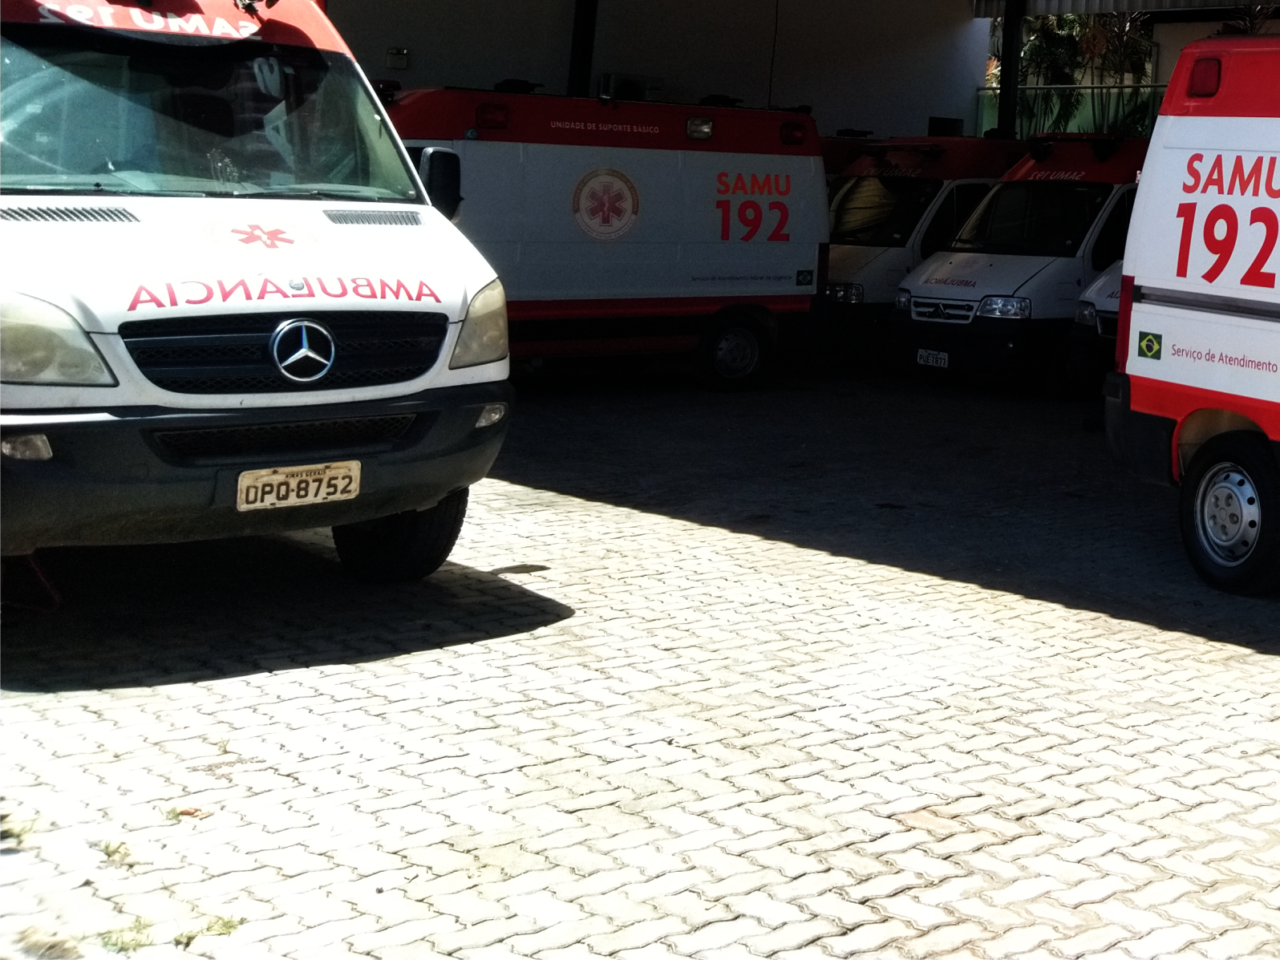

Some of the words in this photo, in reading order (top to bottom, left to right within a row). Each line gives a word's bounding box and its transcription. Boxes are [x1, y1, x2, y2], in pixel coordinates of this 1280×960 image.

[550, 121, 585, 130] UNIDADE
[586, 122, 597, 130] DE
[598, 123, 632, 132] SUPORTE
[716, 171, 791, 196] SAMU
[716, 200, 790, 242] 192
[1176, 202, 1279, 289] 192
[1171, 344, 1203, 363] Serviço
[1204, 349, 1216, 362] de
[1218, 352, 1278, 373] Atendimento
